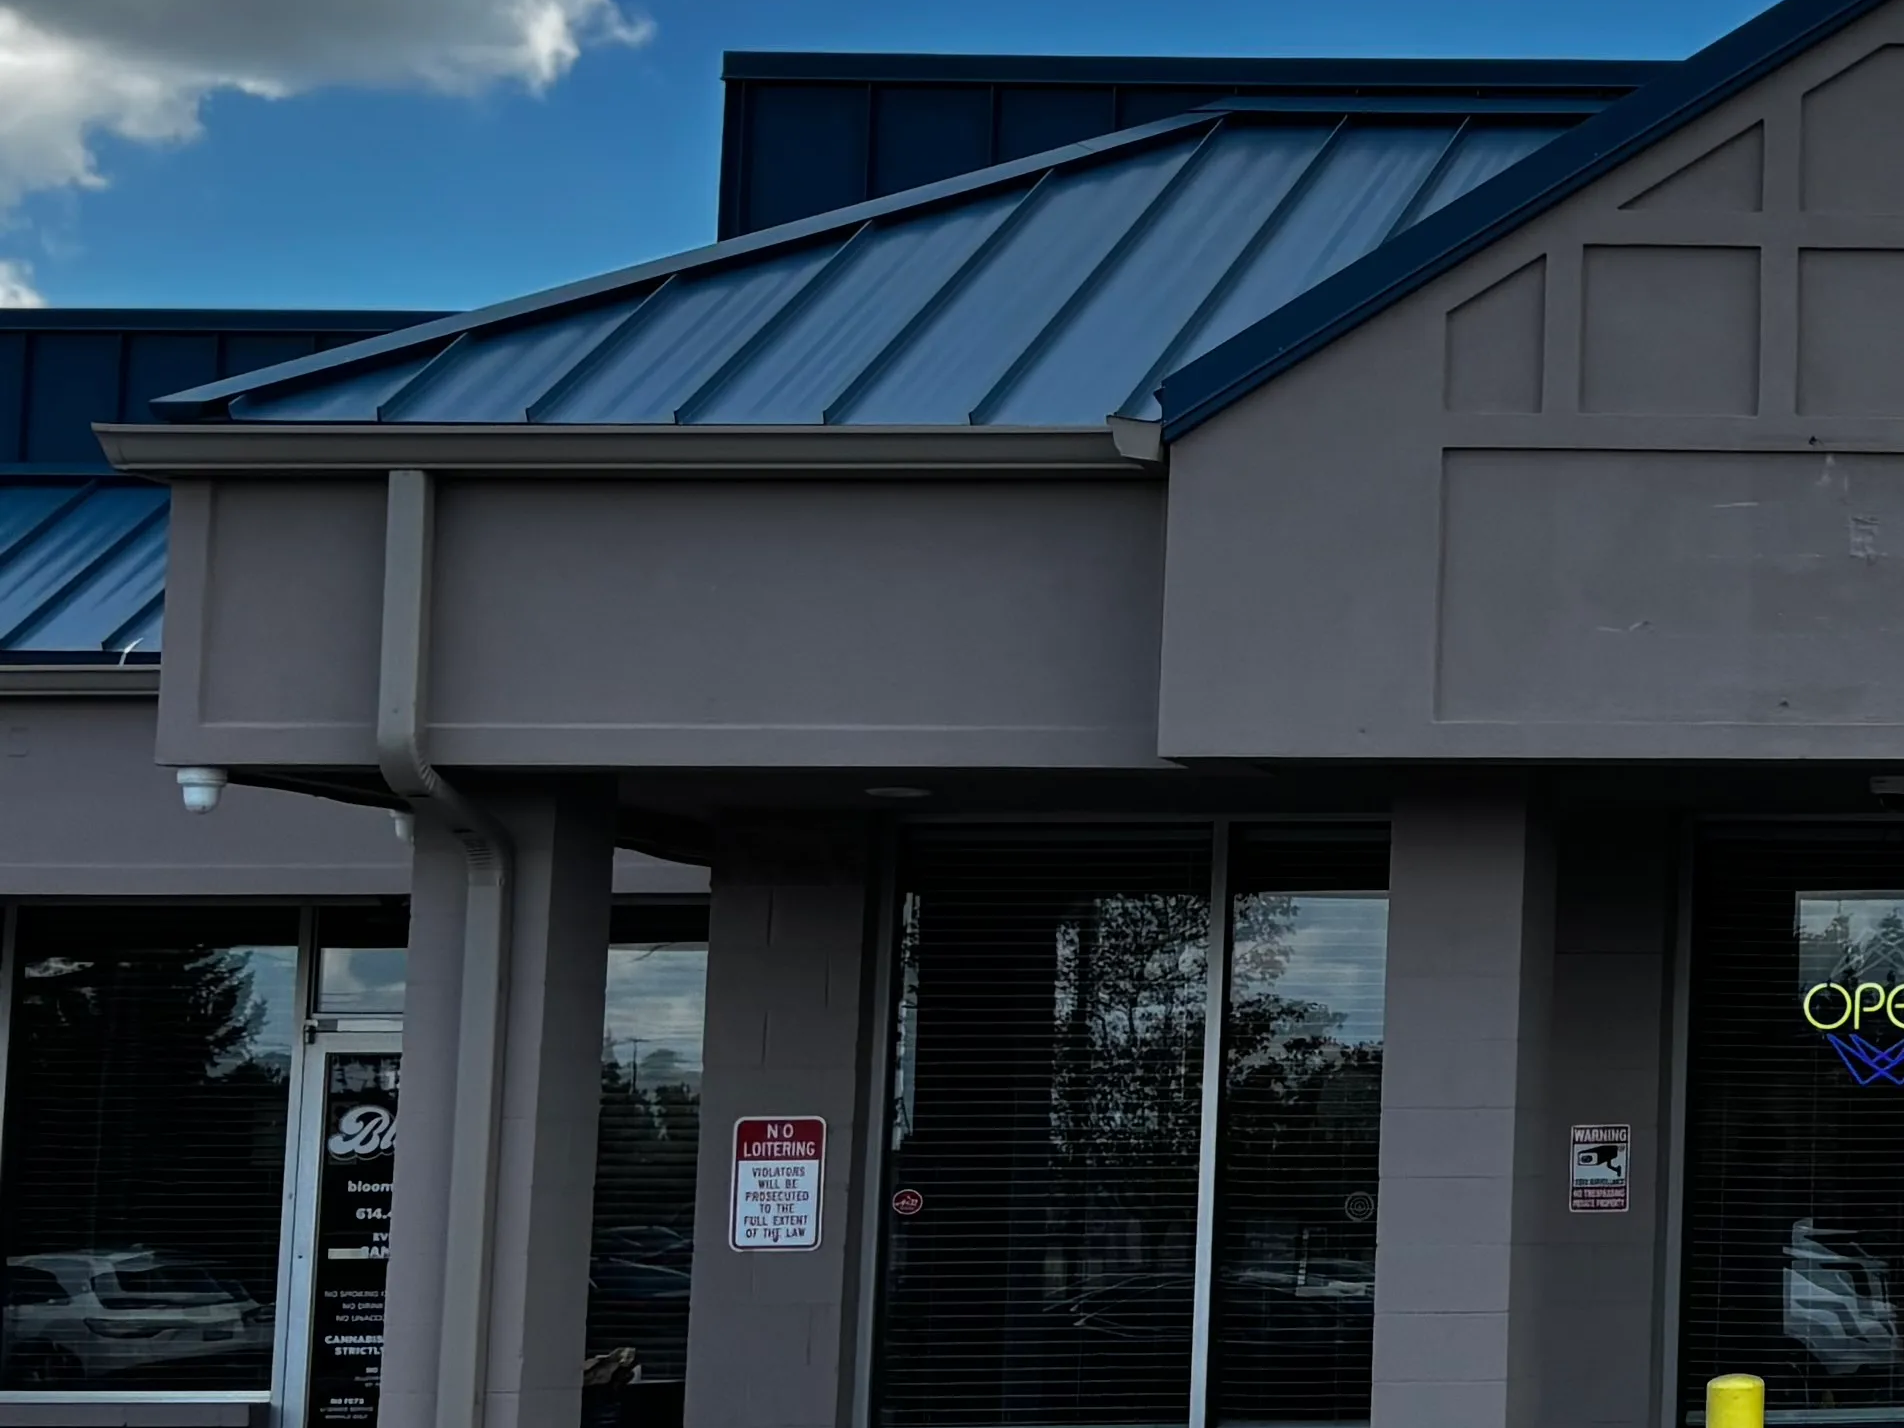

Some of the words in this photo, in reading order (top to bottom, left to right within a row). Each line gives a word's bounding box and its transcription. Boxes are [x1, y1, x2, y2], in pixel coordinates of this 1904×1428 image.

[767, 1123, 794, 1139] NO
[1575, 1129, 1627, 1142] WARNING
[744, 1142, 816, 1157] LOITERING
[752, 1167, 805, 1178] VIOLATORS
[758, 1180, 778, 1189] WILL
[785, 1179, 797, 1189] BE
[745, 1191, 809, 1202] PROSECUTED
[760, 1204, 770, 1214] TO
[777, 1203, 794, 1213] THE
[744, 1216, 767, 1226] FULL
[773, 1215, 808, 1226] EXTENT
[746, 1229, 757, 1238] OF
[763, 1228, 779, 1239] THE
[786, 1228, 806, 1238] LAW
